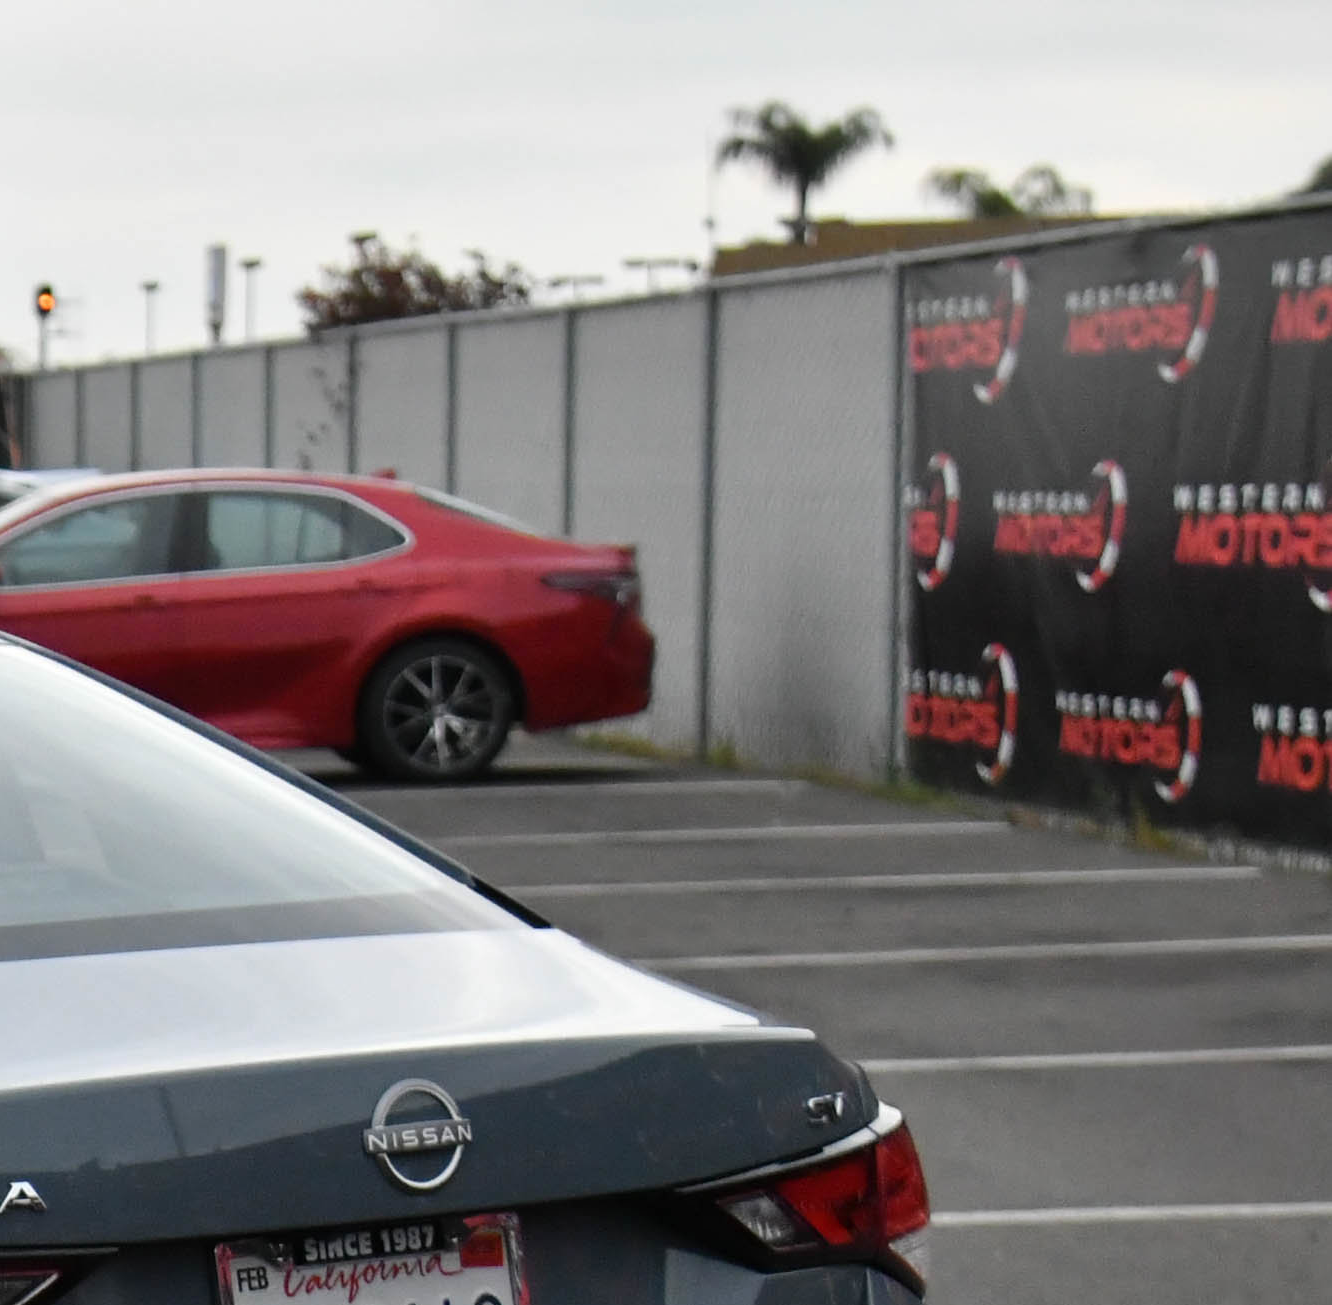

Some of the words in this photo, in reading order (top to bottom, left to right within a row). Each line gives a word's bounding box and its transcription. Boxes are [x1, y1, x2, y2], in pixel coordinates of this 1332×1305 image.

[367, 1122, 473, 1152] NISSAN
[303, 1231, 373, 1261] SINCE
[381, 1225, 435, 1253] 1987
[237, 1266, 269, 1292] FEB
[284, 1252, 462, 1303] California
